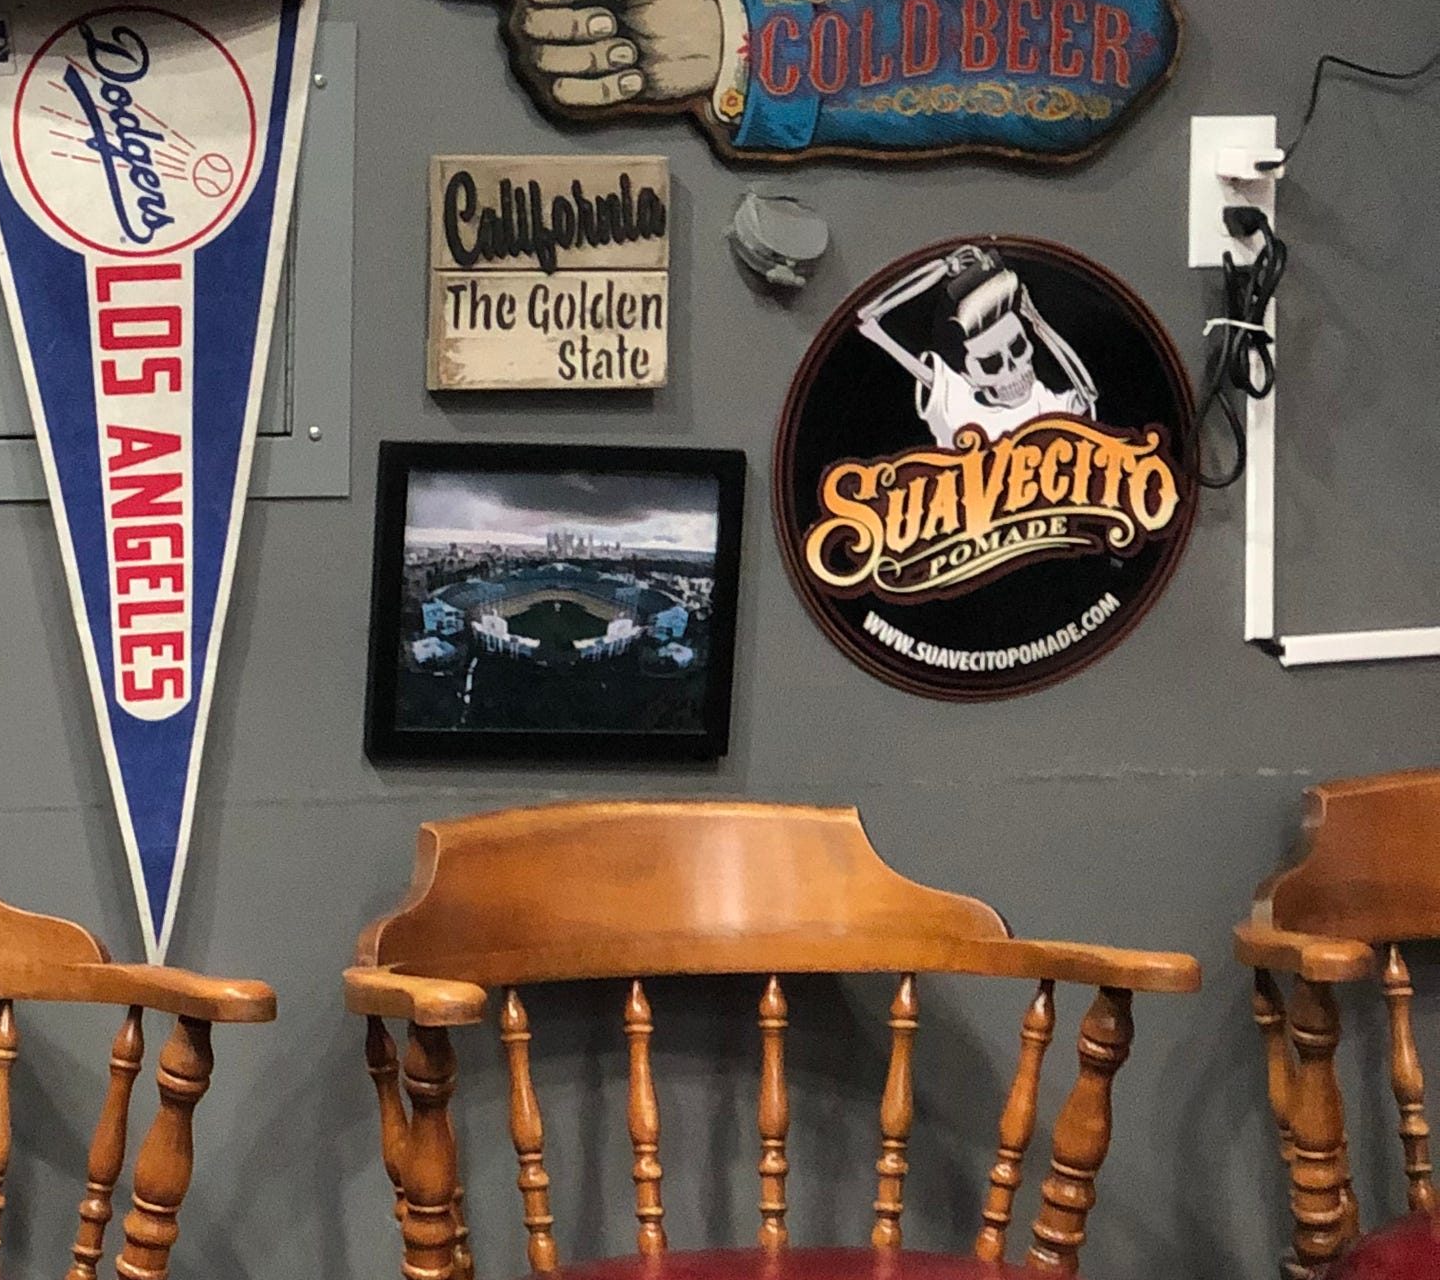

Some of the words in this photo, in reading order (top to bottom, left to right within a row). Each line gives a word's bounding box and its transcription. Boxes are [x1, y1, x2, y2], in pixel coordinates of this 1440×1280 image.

[64, 23, 175, 244] Dodgers
[444, 171, 666, 275] California
[96, 263, 182, 395] LOS
[448, 280, 516, 330] The
[529, 280, 661, 334] Golden
[559, 334, 649, 380] State
[106, 424, 184, 702] ANGELES
[930, 517, 1068, 578] POMADE
[863, 592, 1121, 671] WWW.SUAVECITOPOMADE.COM
